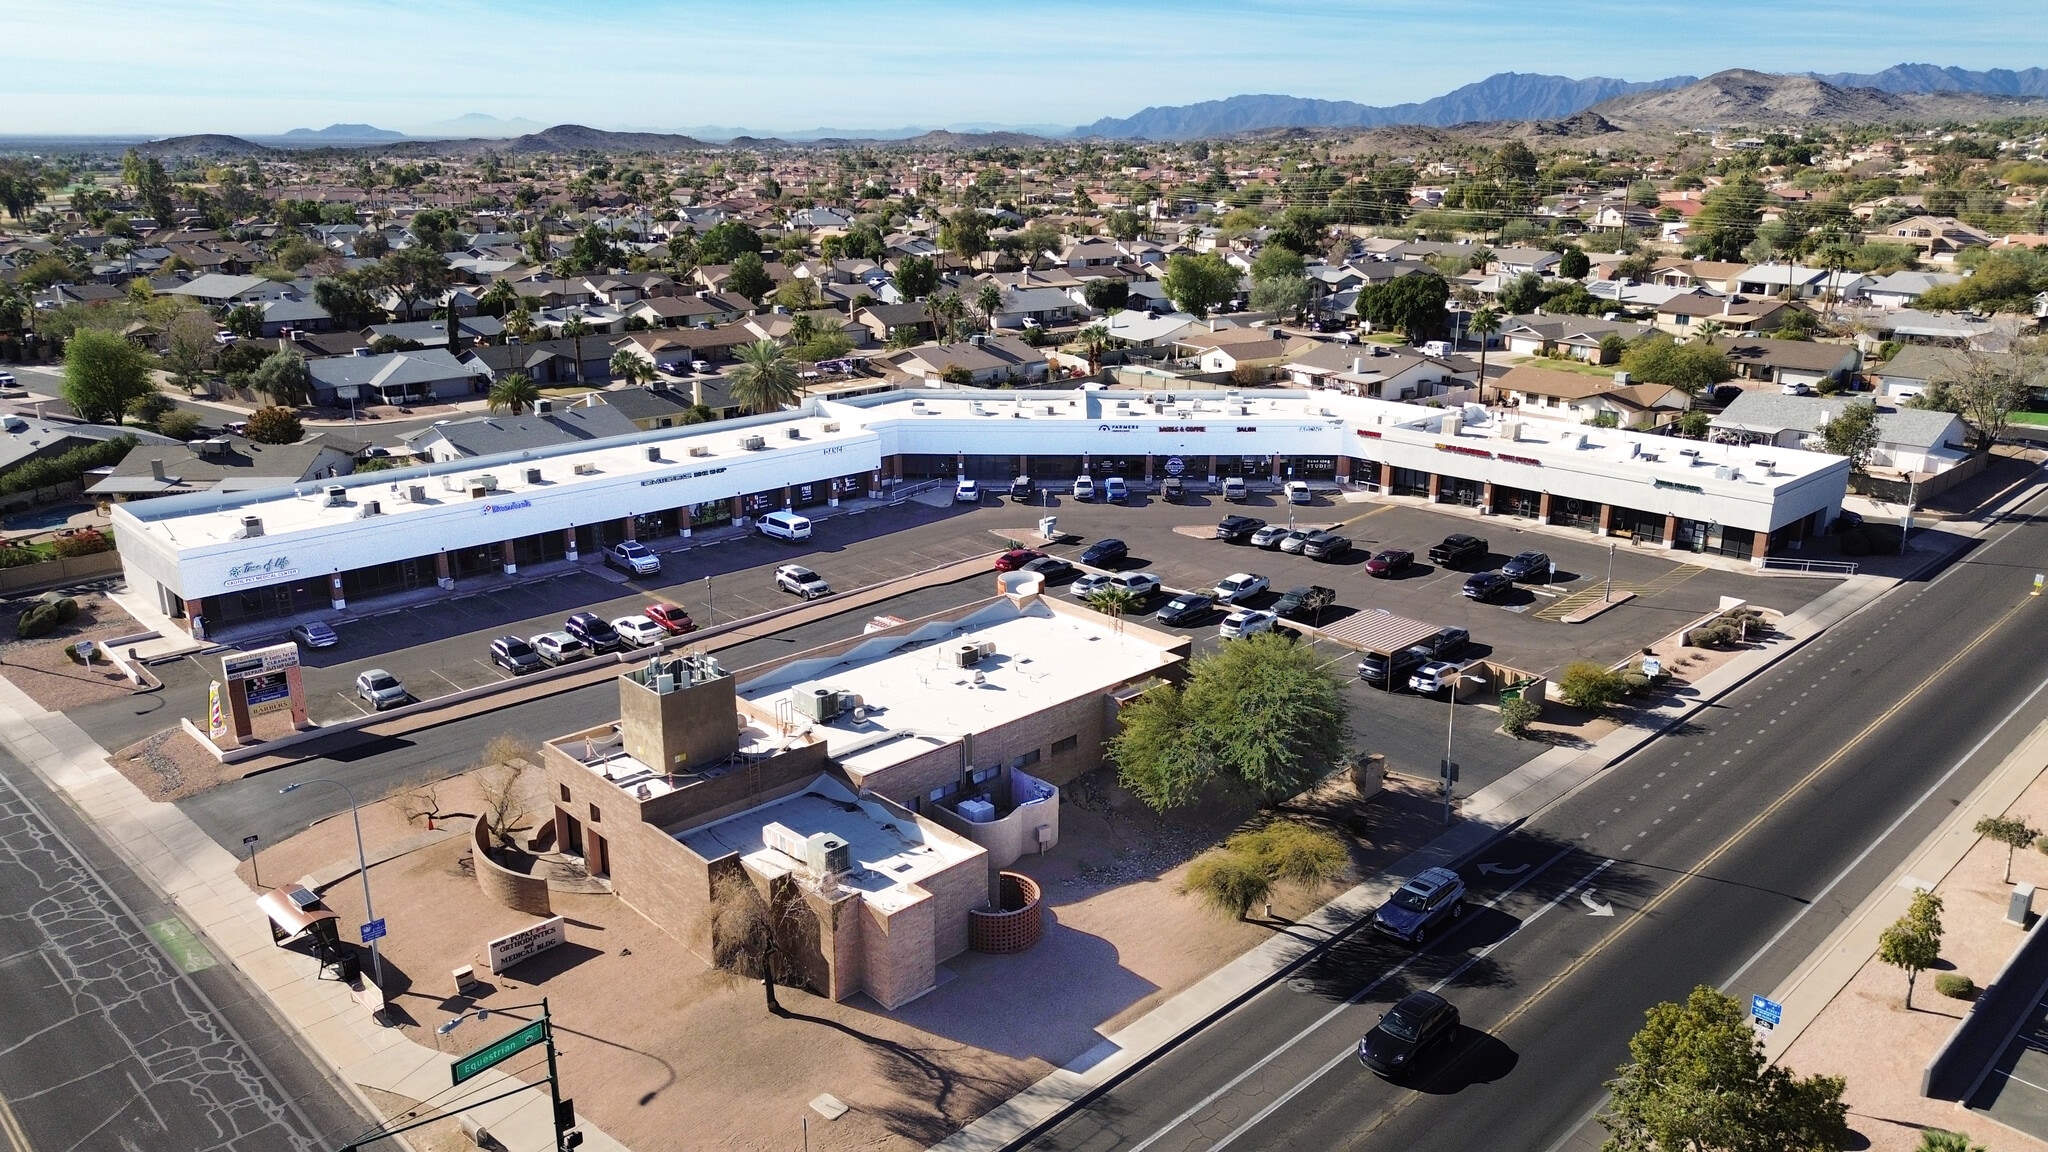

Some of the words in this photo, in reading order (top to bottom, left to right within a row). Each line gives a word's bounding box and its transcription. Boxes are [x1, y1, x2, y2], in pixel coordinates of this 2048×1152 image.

[243, 562, 261, 573] Tree
[264, 559, 273, 572] of
[267, 657, 295, 666] CLEANERS
[253, 702, 288, 713] BARBERS
[500, 927, 556, 953] ORTHODONTICS
[511, 929, 533, 942] POPAT
[501, 948, 535, 965] MEDICAL
[537, 939, 556, 950] BLDG
[464, 1042, 516, 1073] Equestrian
